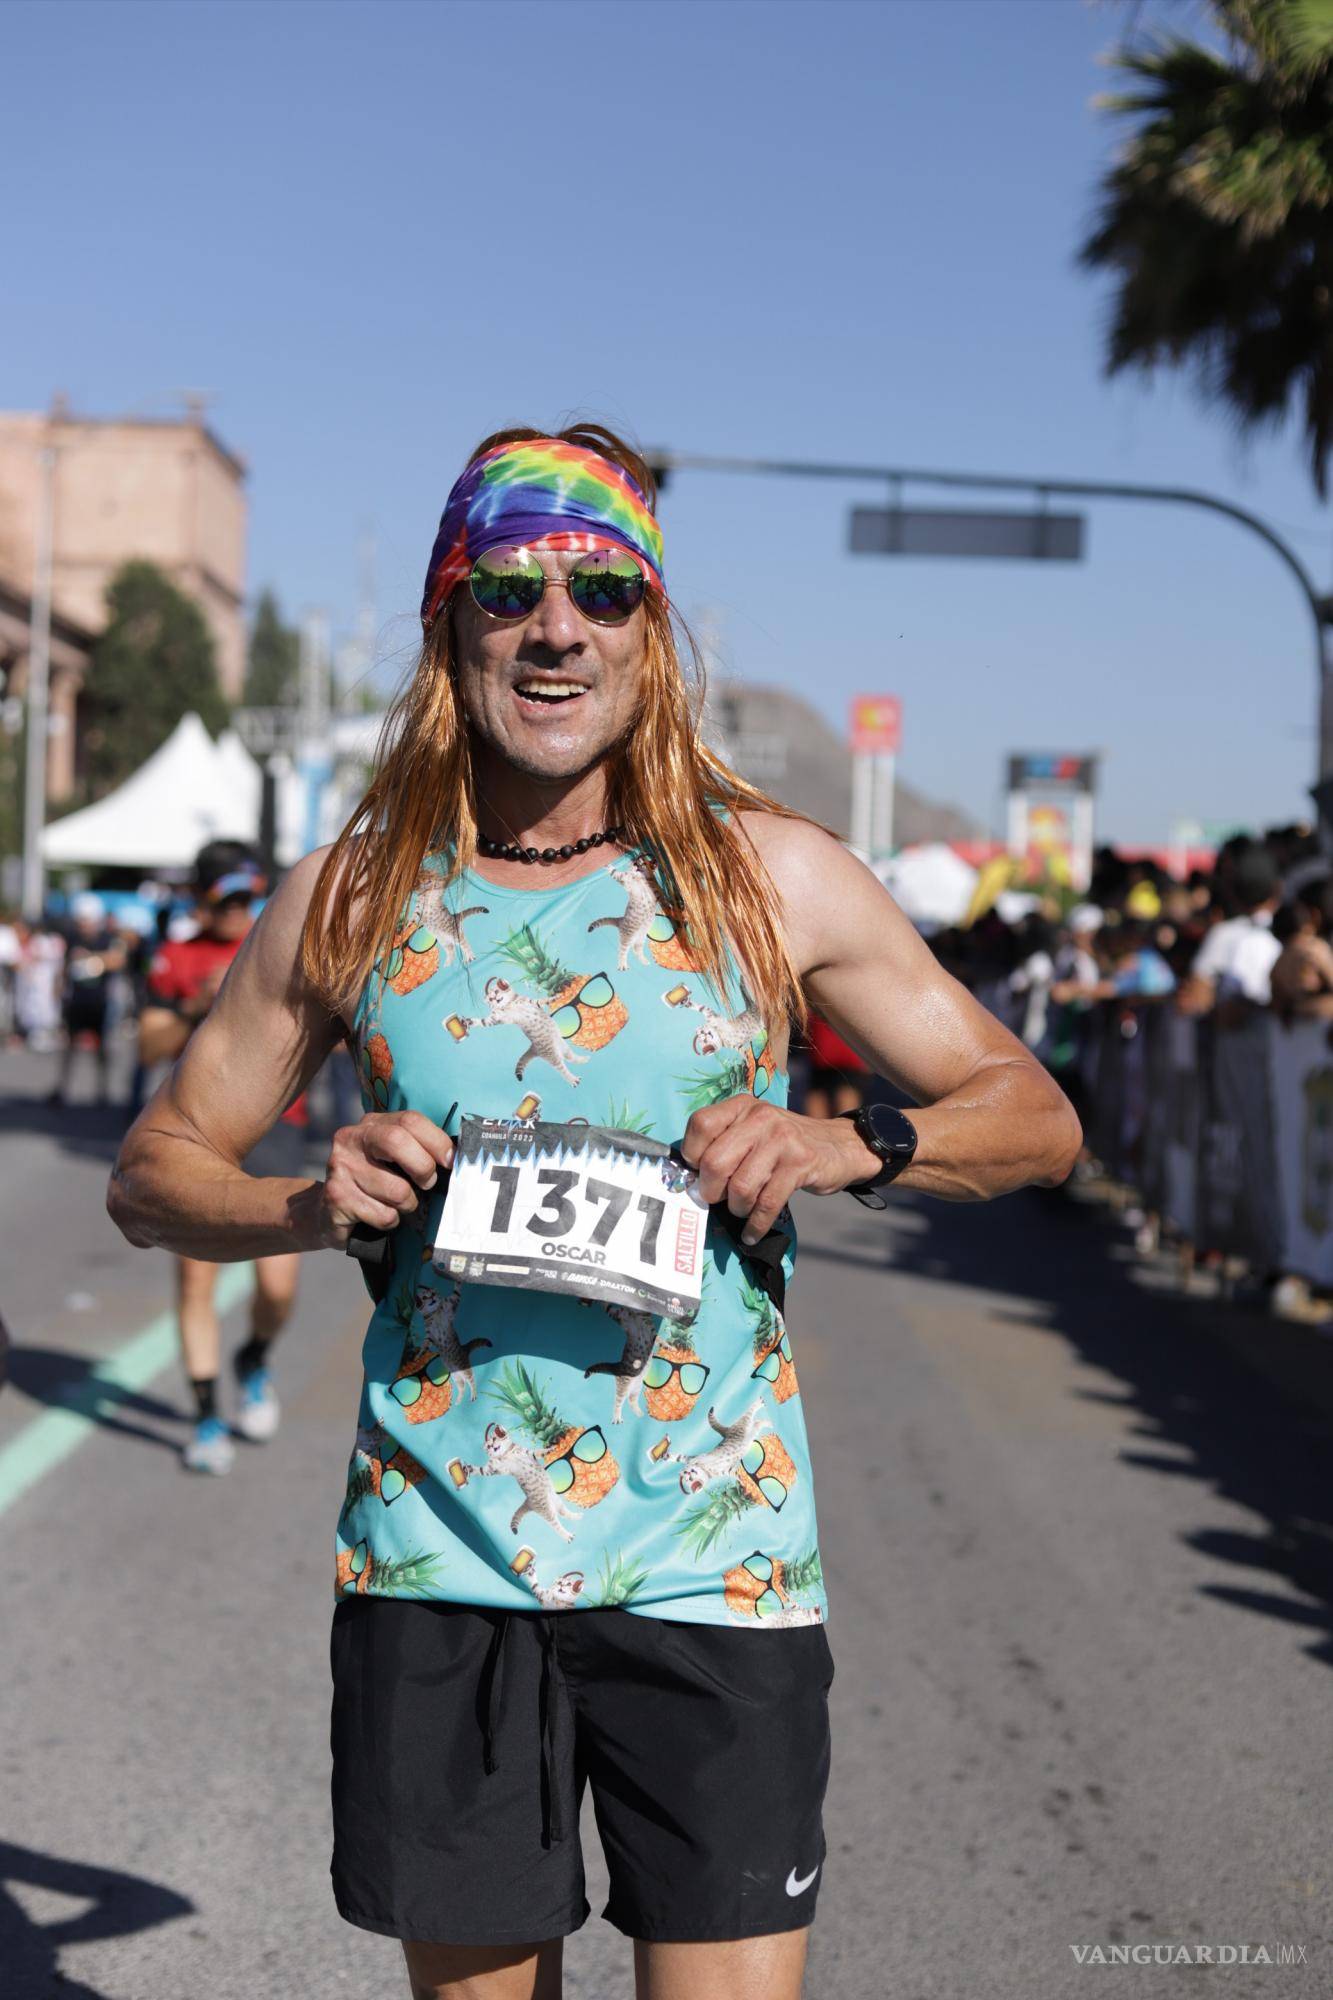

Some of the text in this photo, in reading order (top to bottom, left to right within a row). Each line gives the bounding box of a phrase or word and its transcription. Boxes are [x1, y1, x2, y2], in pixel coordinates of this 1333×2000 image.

[513, 1133, 534, 1142] 2023
[490, 1165, 666, 1266] 1371
[541, 1242, 606, 1265] OSCAR
[676, 1210, 698, 1274] SALTILLO
